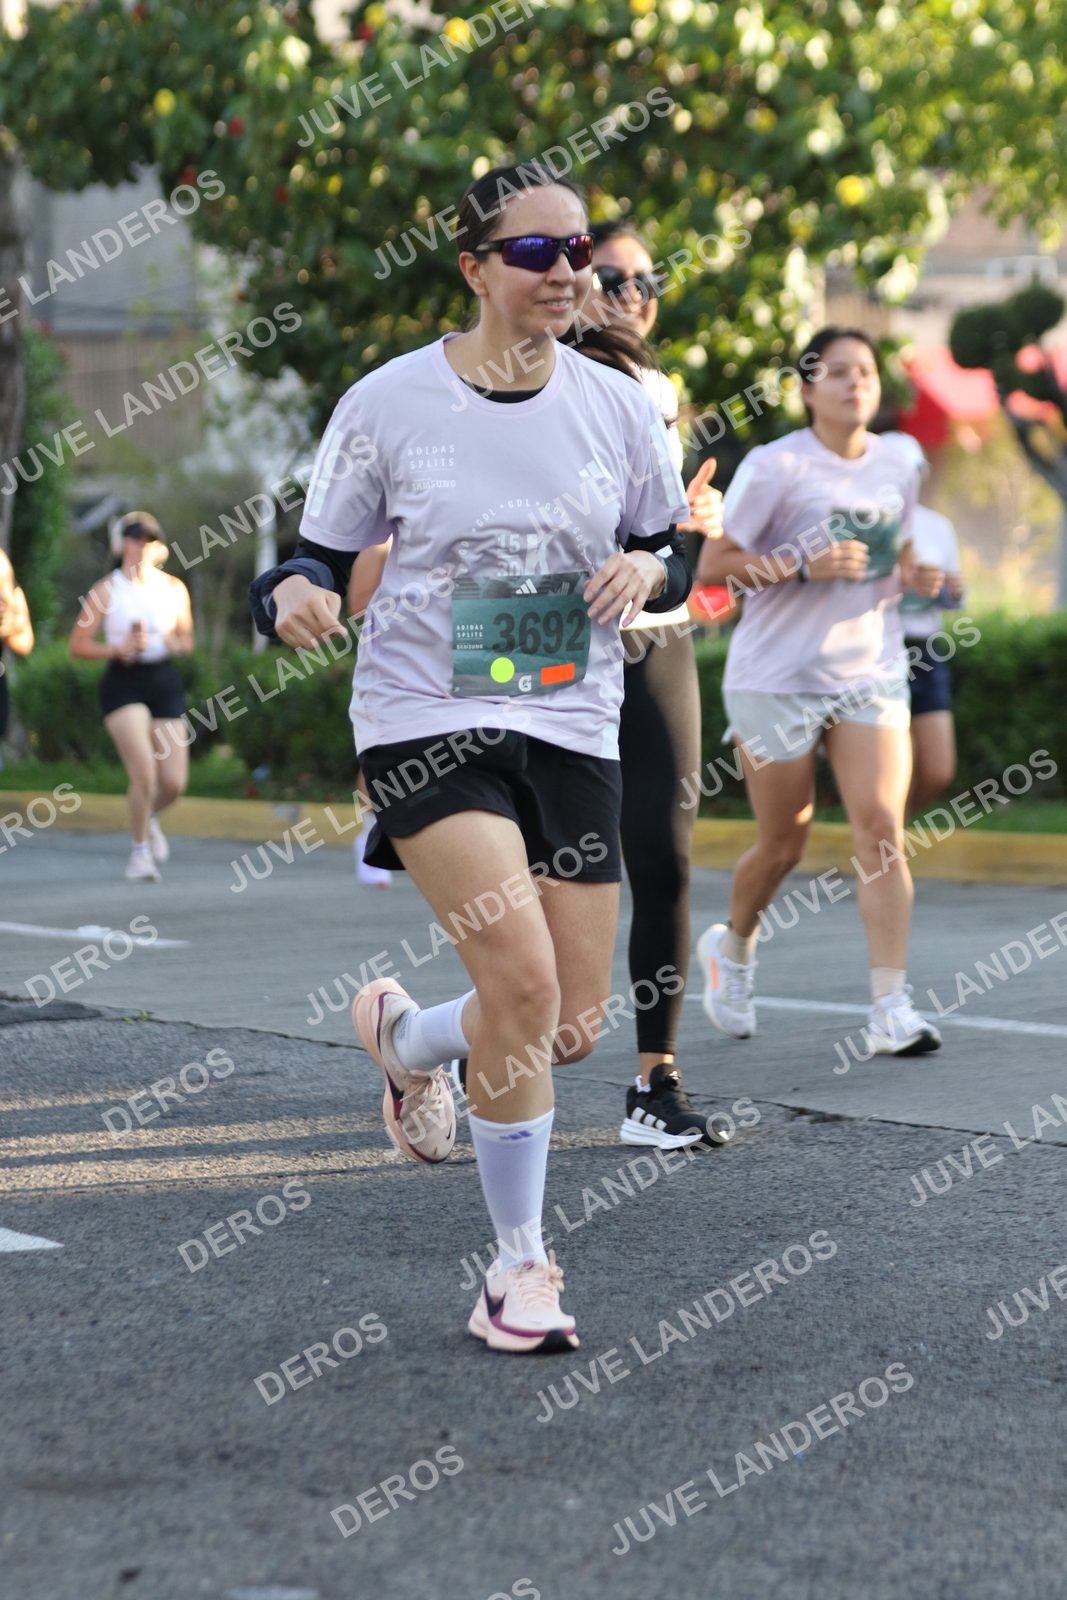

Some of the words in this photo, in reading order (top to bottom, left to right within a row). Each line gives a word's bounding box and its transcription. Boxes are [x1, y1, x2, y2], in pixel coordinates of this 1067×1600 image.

[408, 444, 455, 456] ADIDAS
[410, 458, 454, 470] SPLITS
[507, 498, 530, 509] GDL
[492, 608, 586, 655] 3692
